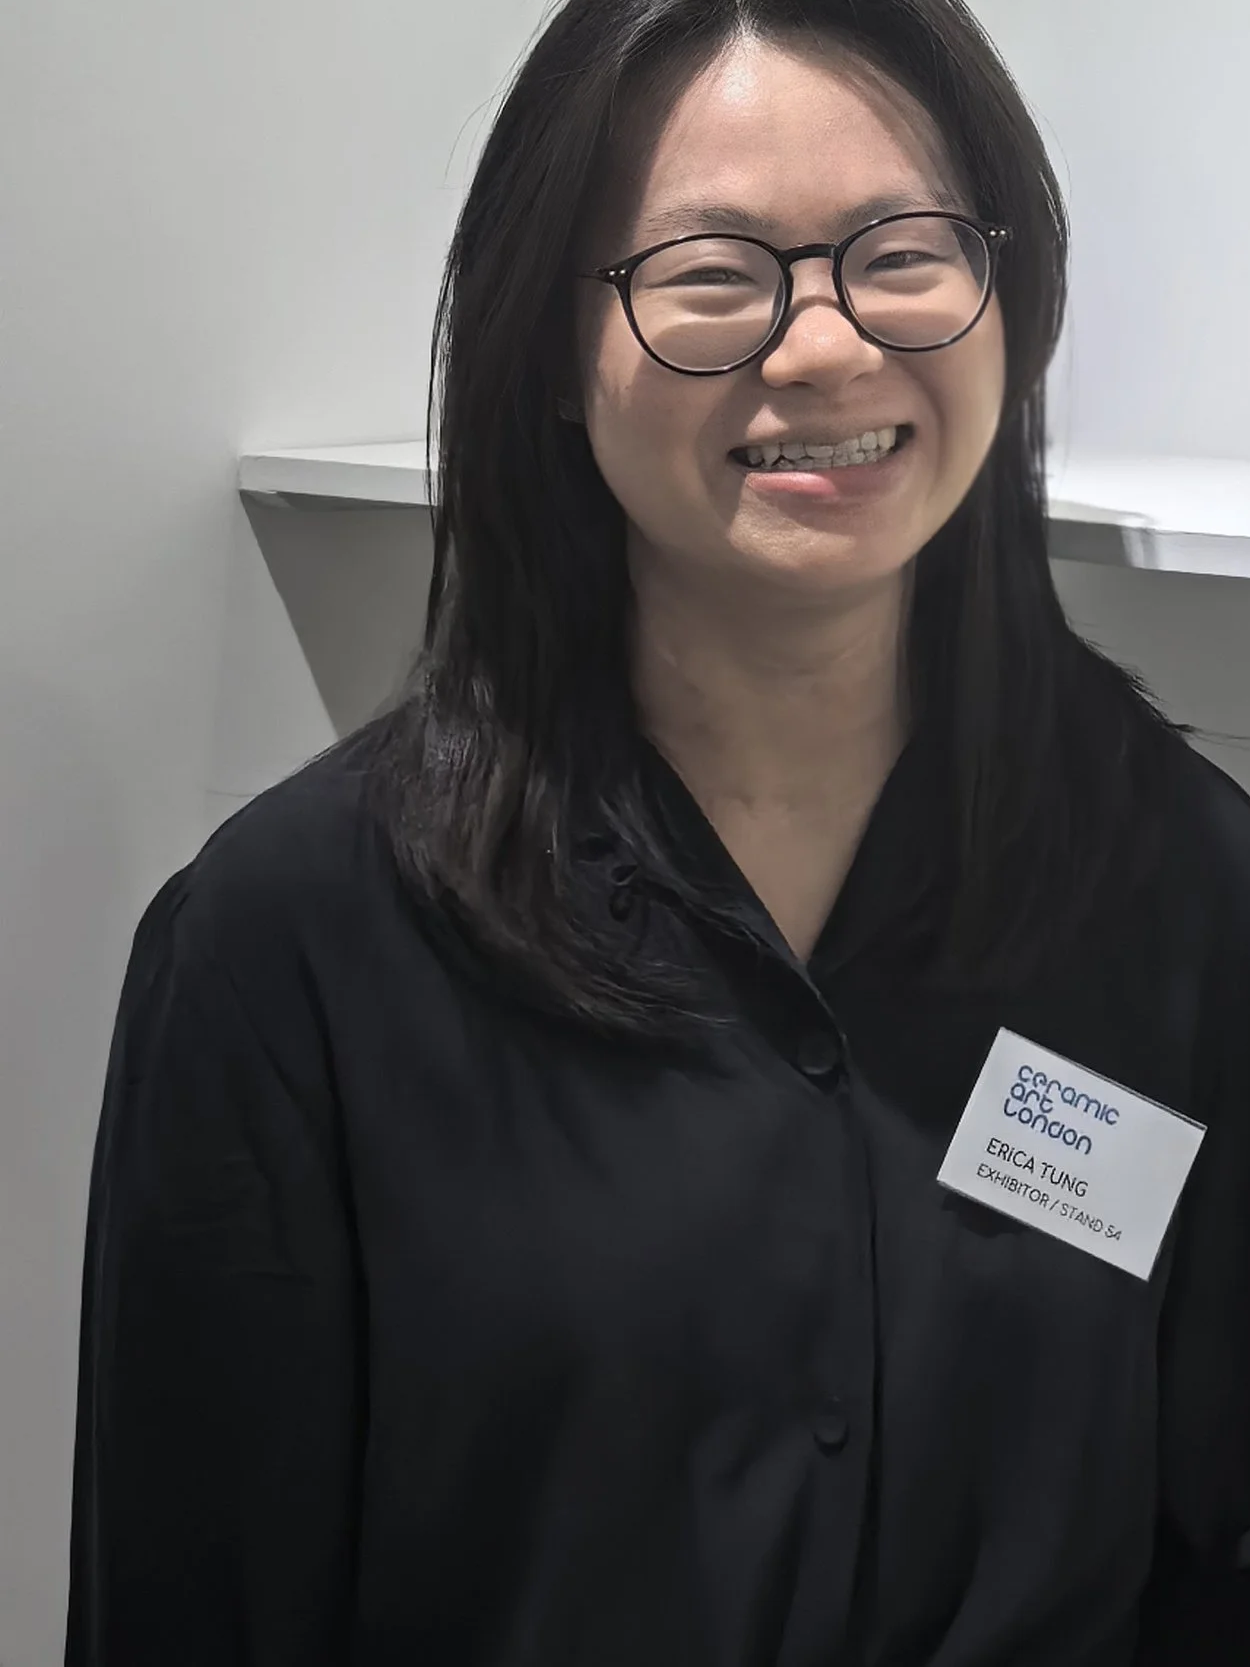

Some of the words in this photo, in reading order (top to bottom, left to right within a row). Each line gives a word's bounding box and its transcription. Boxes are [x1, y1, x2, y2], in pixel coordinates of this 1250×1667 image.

[1010, 1082, 1053, 1113] art
[1018, 1065, 1120, 1125] ceramic
[986, 1137, 1035, 1174] ERICA
[1040, 1162, 1089, 1197] TUNG
[976, 1163, 1050, 1208] EXHIBITOR
[1060, 1203, 1103, 1233] STAND
